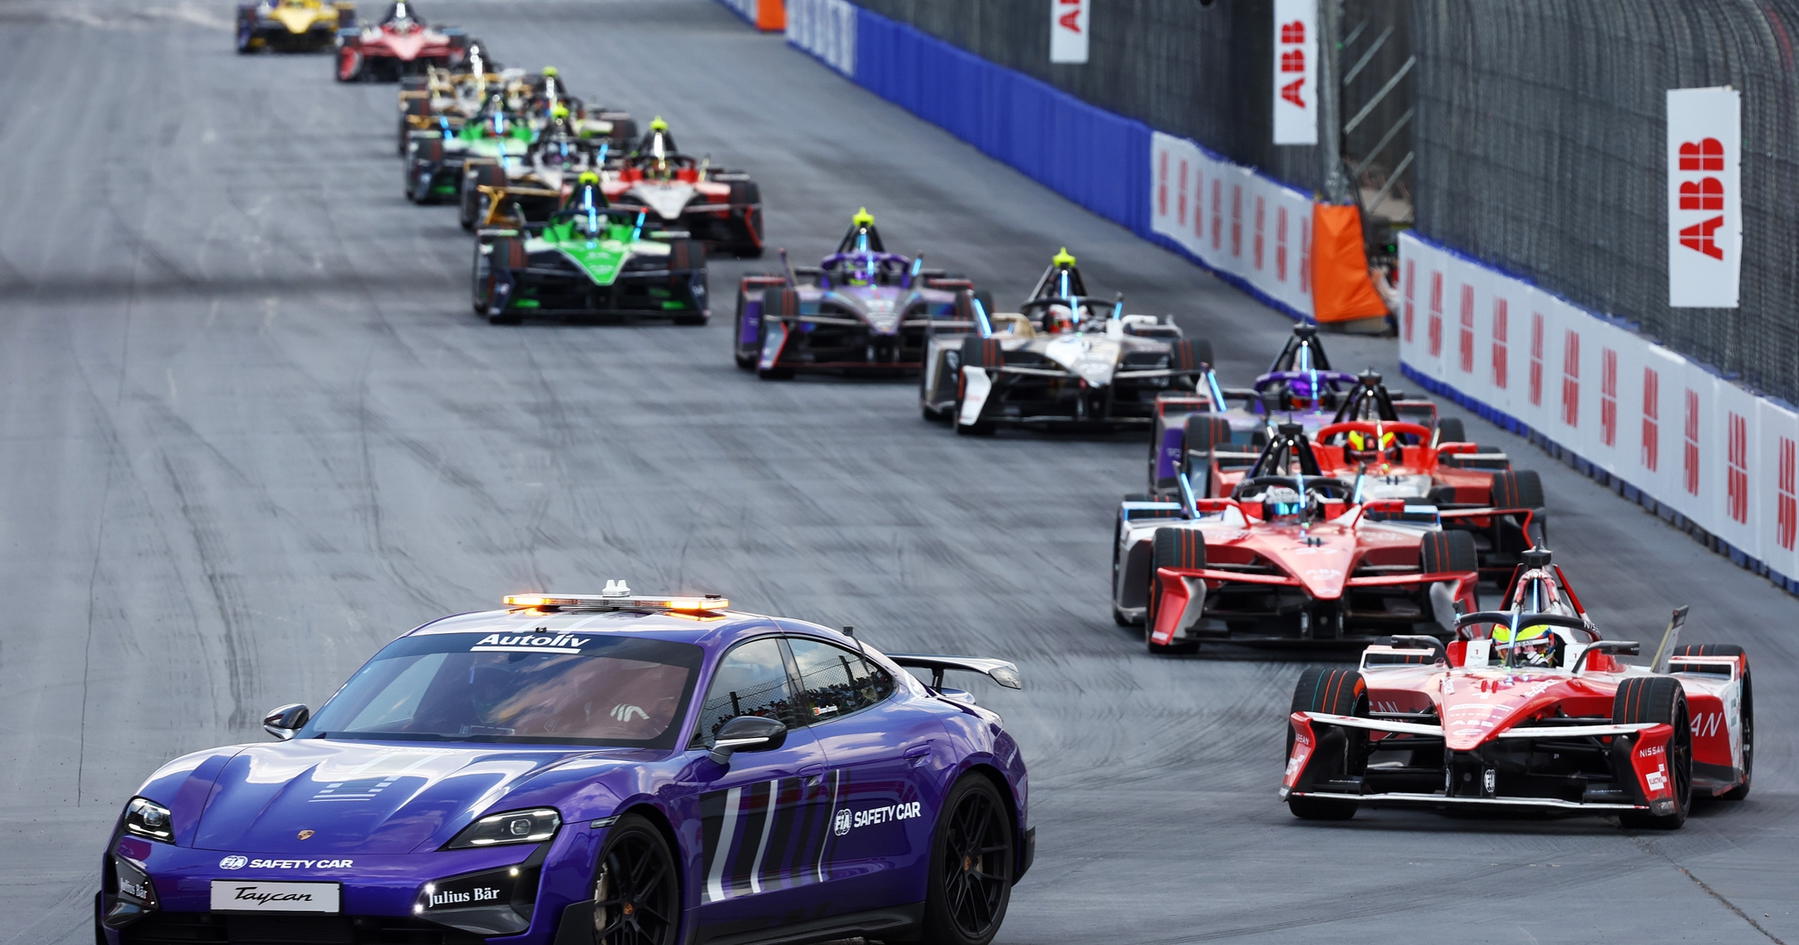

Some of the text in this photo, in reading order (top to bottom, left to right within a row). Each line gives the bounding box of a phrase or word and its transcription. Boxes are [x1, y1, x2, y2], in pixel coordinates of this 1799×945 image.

[1281, 20, 1306, 109] ABB
[1679, 137, 1725, 261] ABB
[476, 633, 591, 647] Autoliv
[853, 804, 896, 828] SAFETY
[896, 801, 921, 820] CAR
[249, 859, 316, 869] SAFETY
[316, 859, 353, 869] CAR
[234, 887, 312, 906] Taycan
[428, 887, 500, 908] Julius Bär
